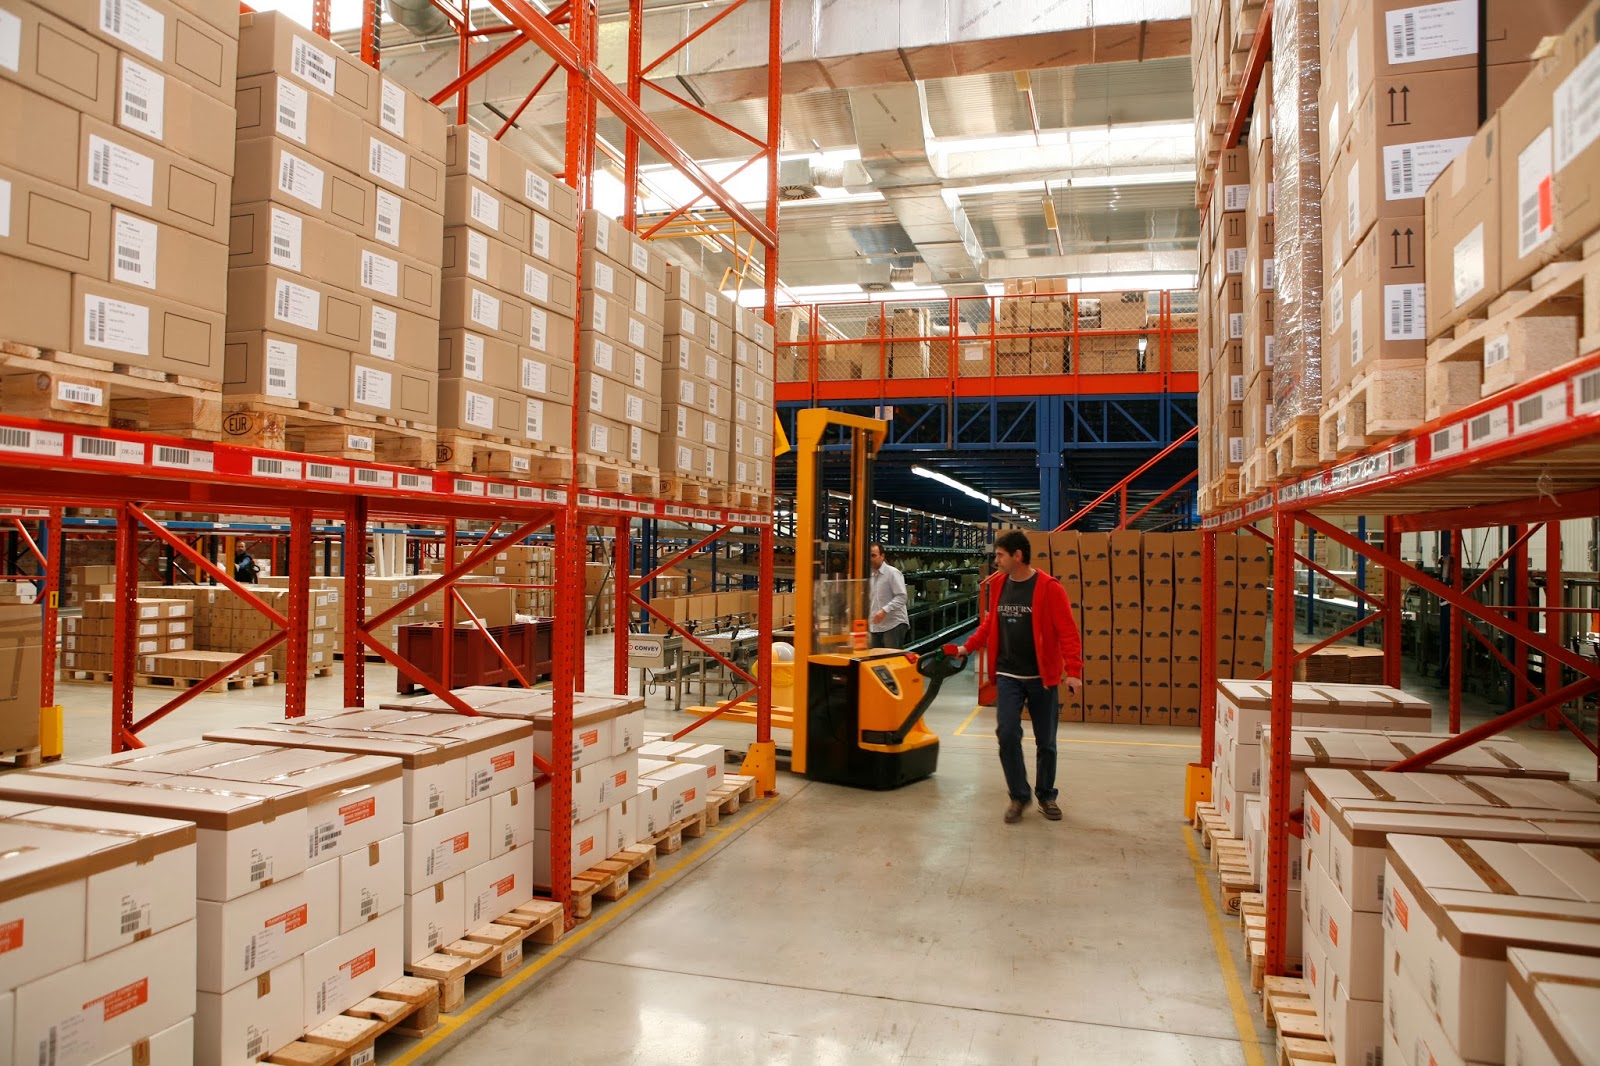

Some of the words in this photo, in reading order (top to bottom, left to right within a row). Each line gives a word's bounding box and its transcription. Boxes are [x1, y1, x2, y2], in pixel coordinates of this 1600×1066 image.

[230, 416, 246, 432] EUR
[437, 448, 448, 460] UR
[52, 594, 56, 606] 1
